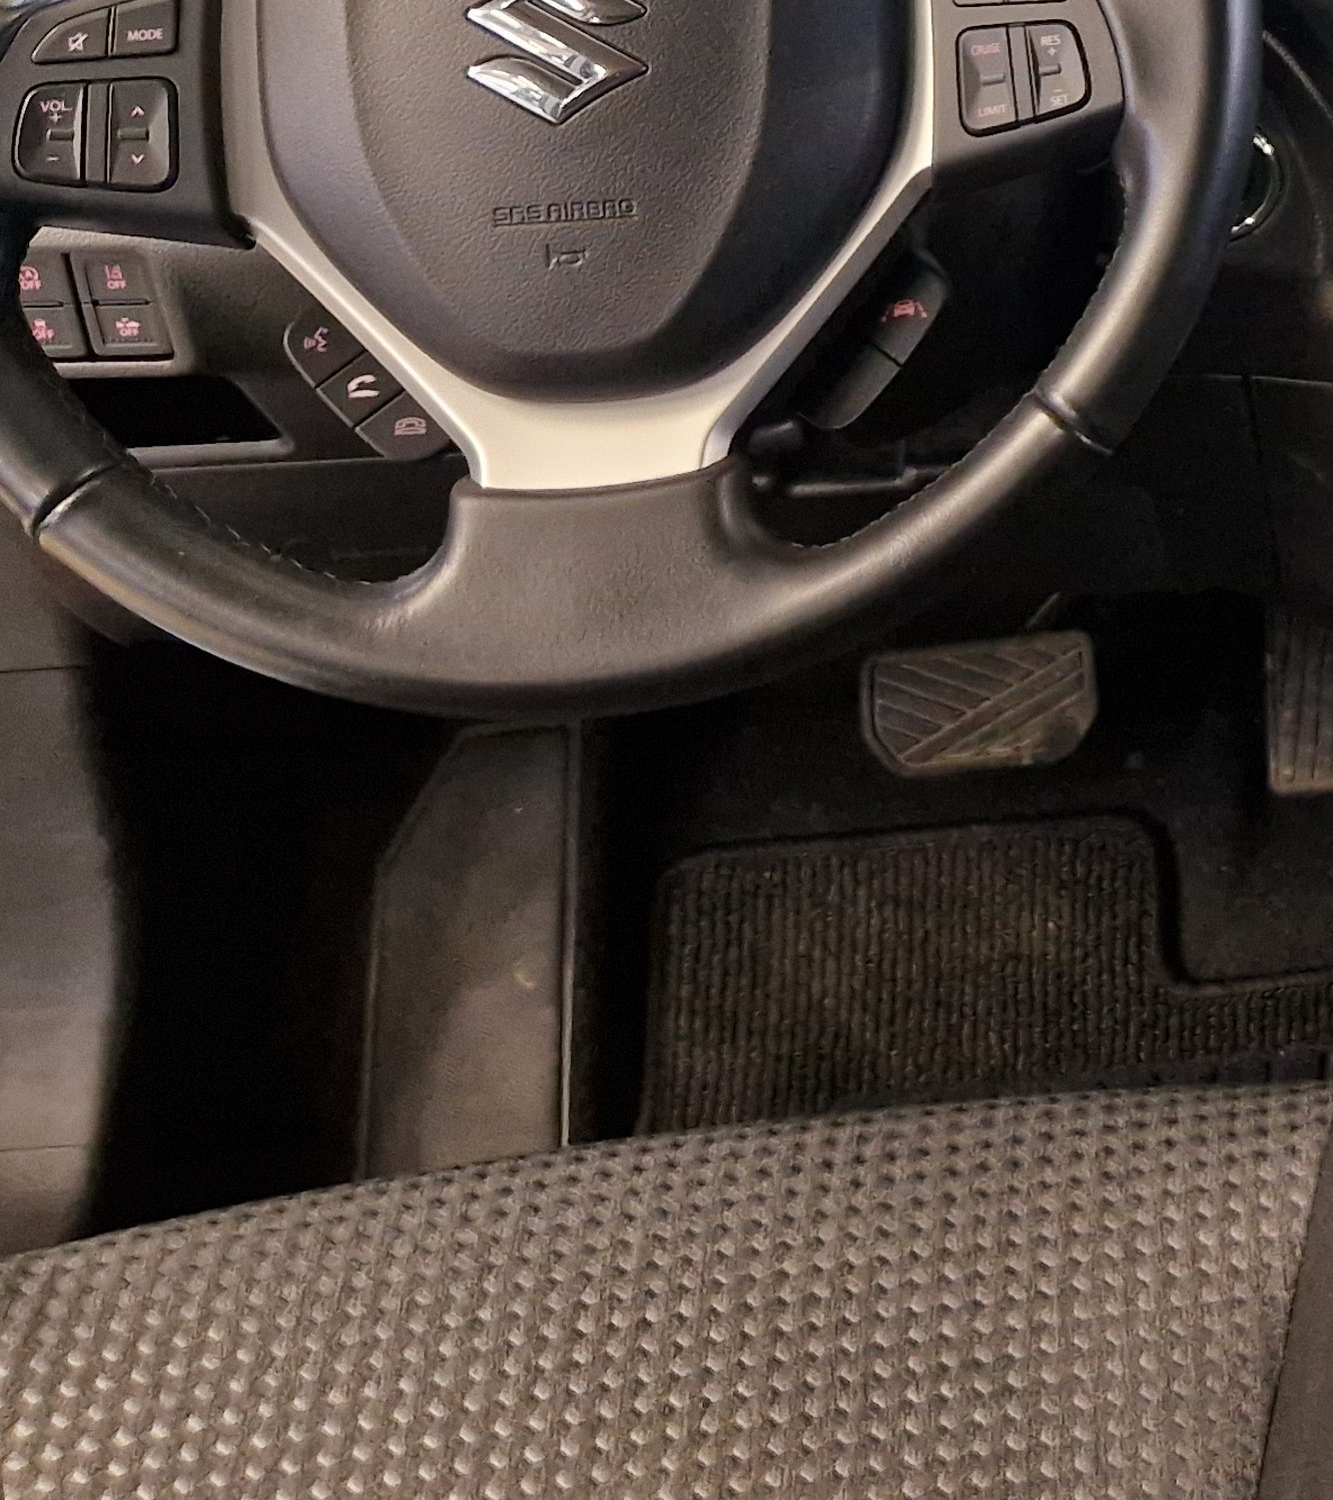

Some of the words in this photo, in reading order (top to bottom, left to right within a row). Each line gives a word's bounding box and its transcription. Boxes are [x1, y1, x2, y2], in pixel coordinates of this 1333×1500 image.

[127, 28, 163, 41] MODE
[1040, 35, 1061, 46] RES
[971, 43, 1001, 55] CRUISE
[40, 100, 73, 112] VOL
[1050, 94, 1069, 107] SET
[978, 104, 1007, 117] LIMIT
[20, 280, 42, 290] OFF
[106, 280, 127, 290] OFF
[119, 328, 140, 337] OFF
